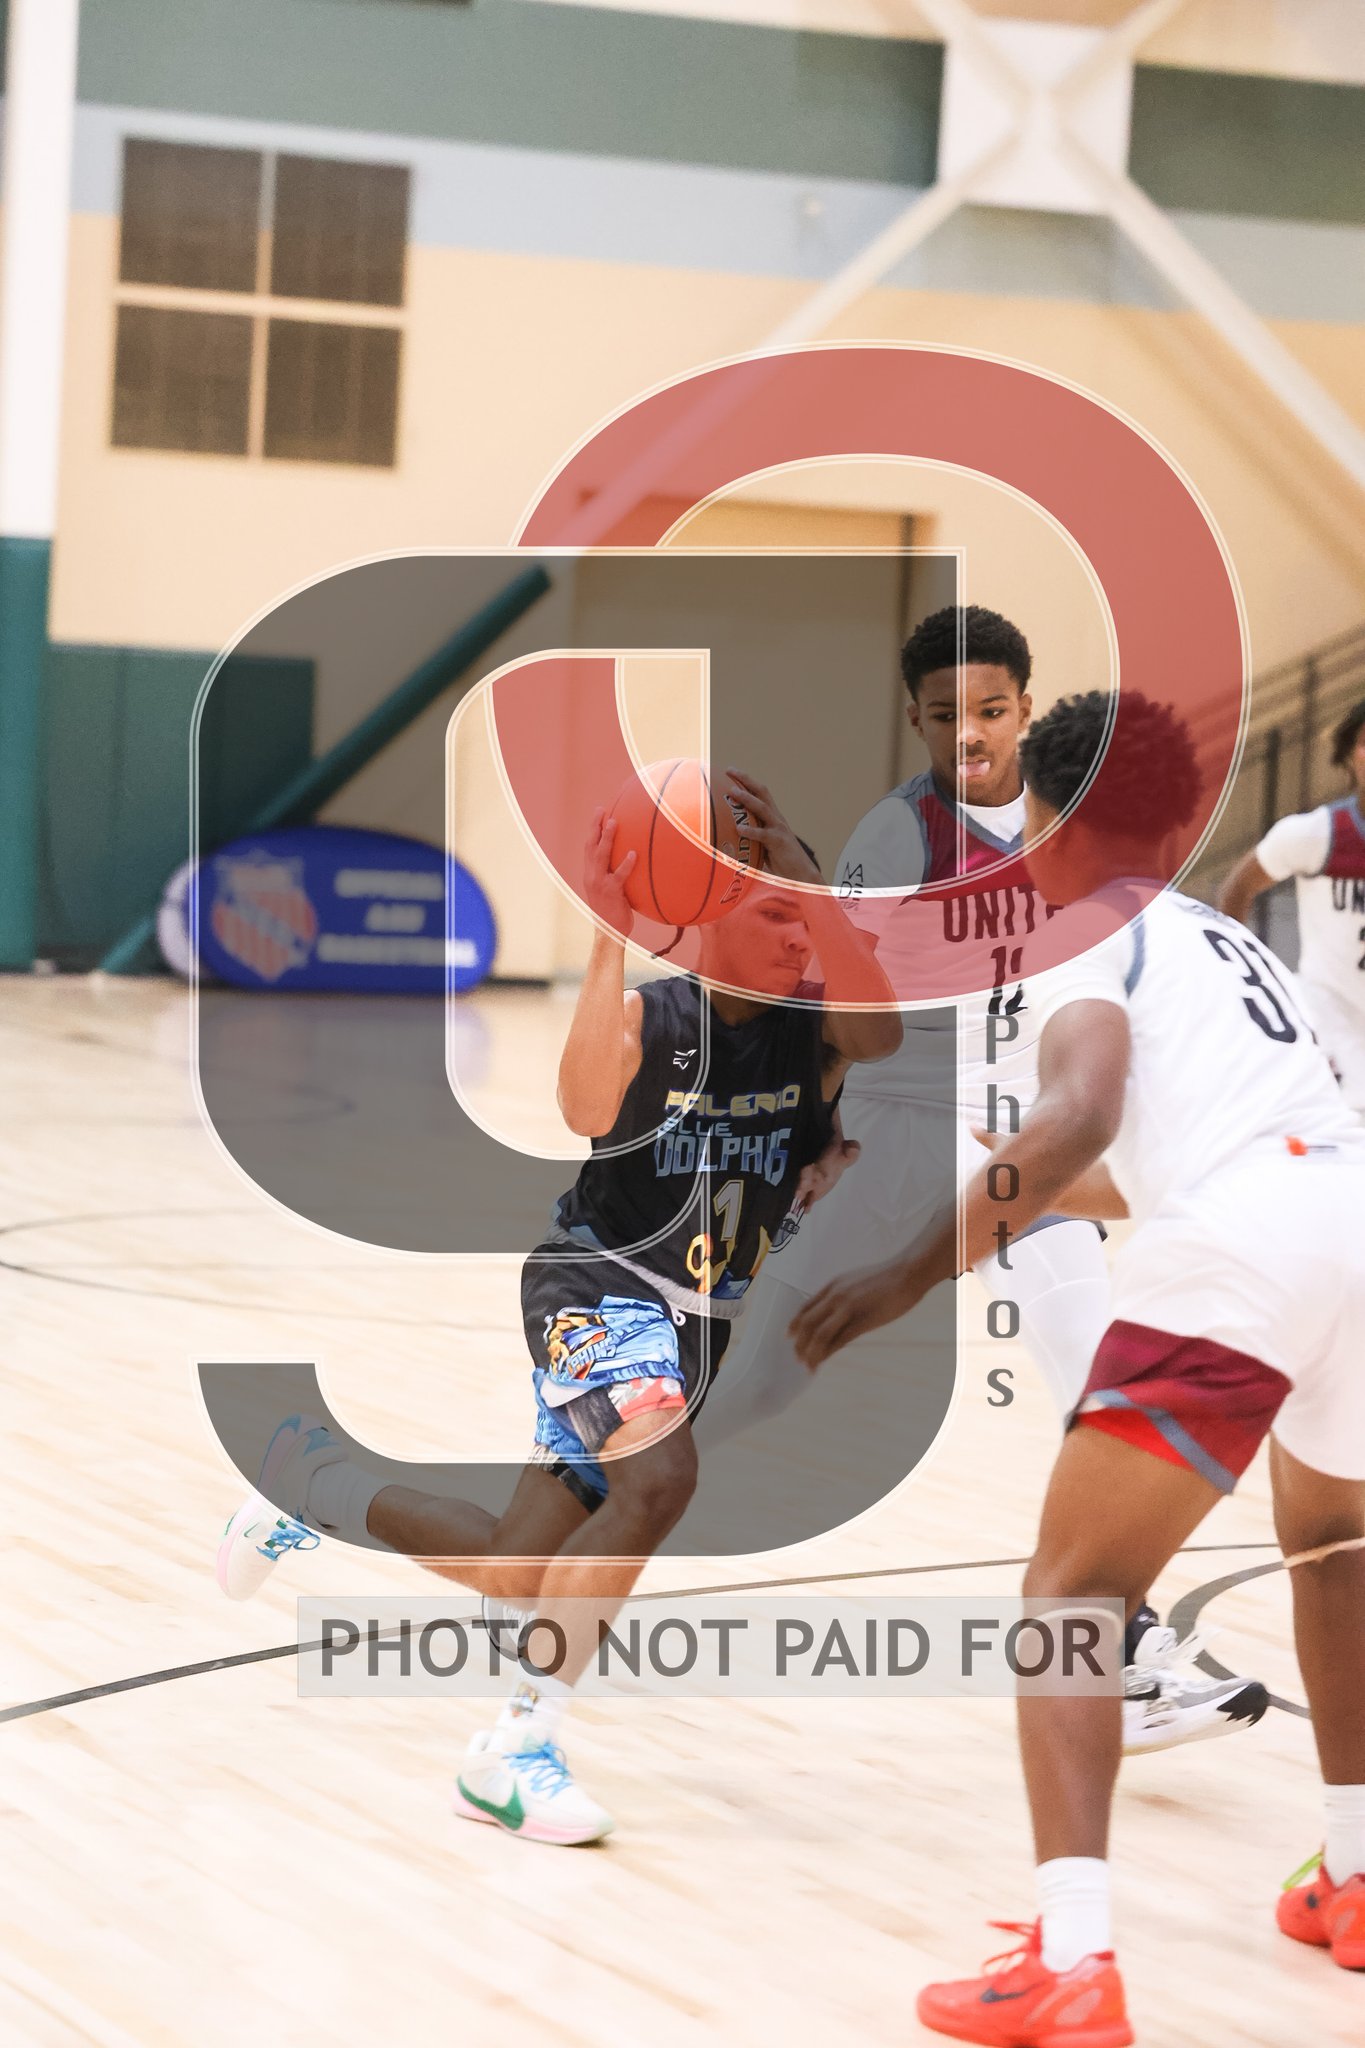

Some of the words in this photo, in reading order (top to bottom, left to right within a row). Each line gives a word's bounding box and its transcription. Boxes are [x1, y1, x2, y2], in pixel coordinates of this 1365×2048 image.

[719, 793, 750, 905] SPALDNG
[665, 1084, 800, 1117] PALERO
[713, 1180, 744, 1241] 1
